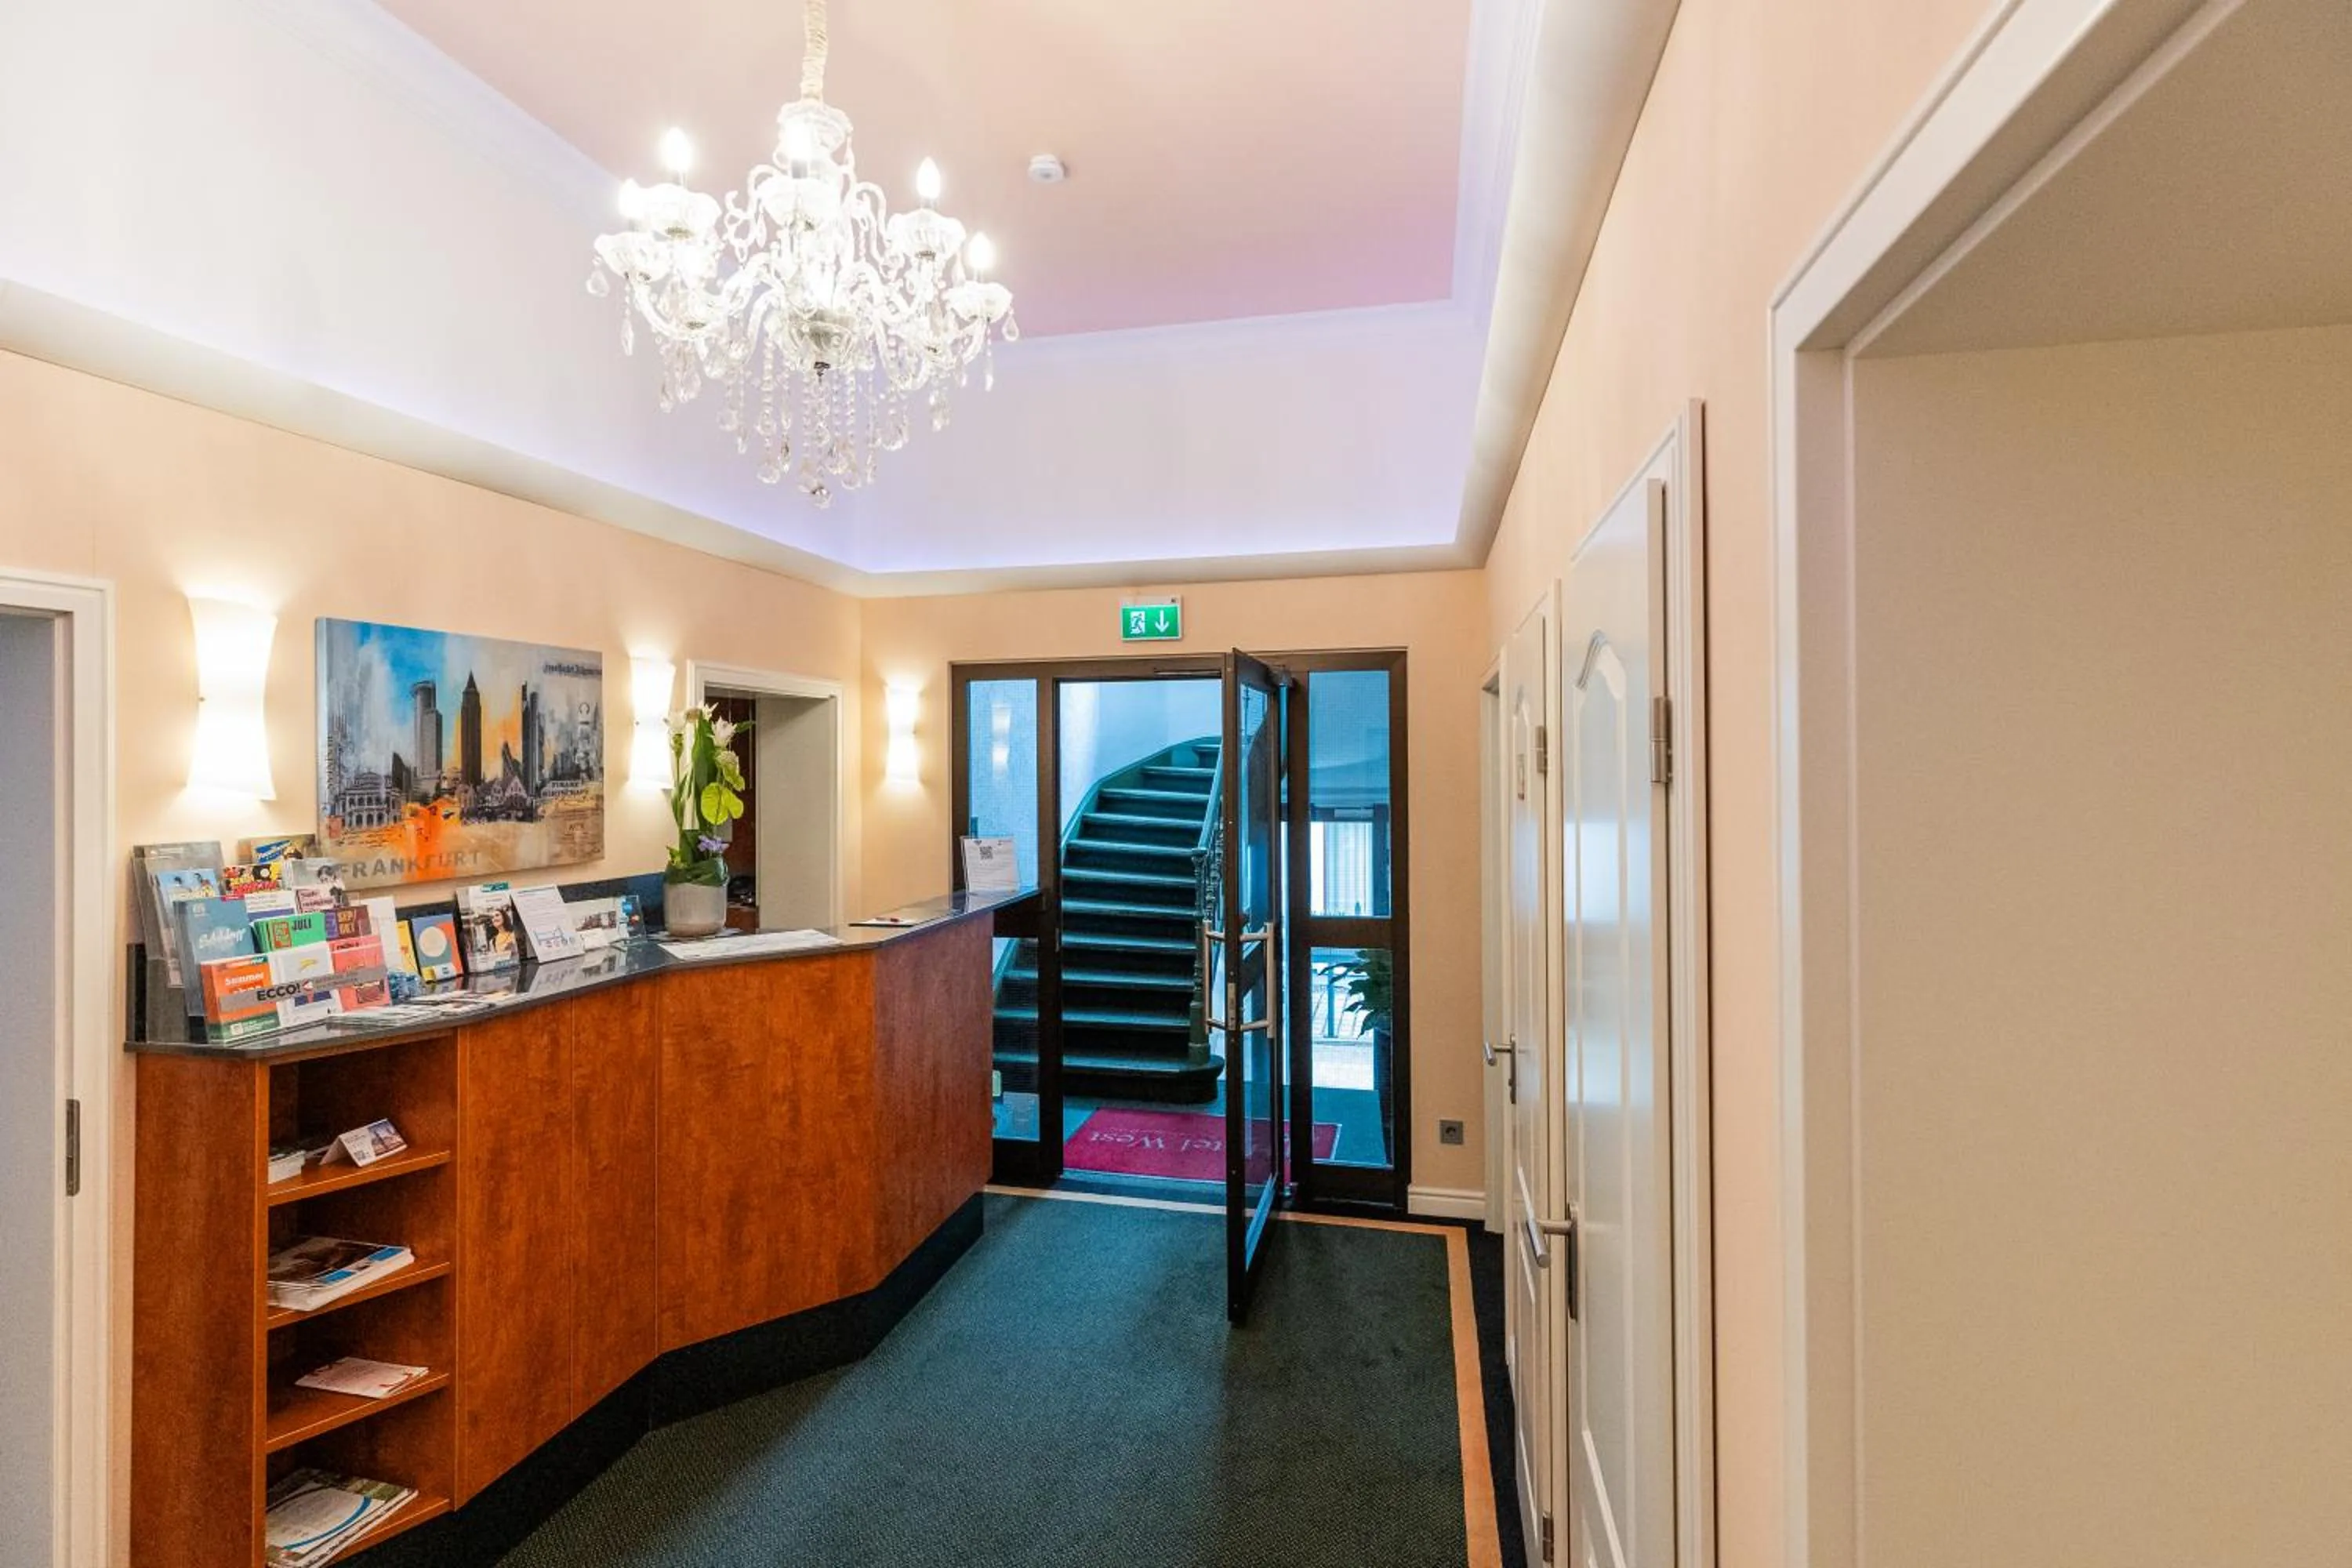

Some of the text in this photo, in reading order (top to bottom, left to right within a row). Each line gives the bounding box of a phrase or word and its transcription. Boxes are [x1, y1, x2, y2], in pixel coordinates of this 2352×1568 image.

[338, 851, 481, 879] FRANKFURT
[292, 917, 312, 931] JULI
[256, 982, 301, 1002] ECCO!
[1091, 1131, 1166, 1149] West
